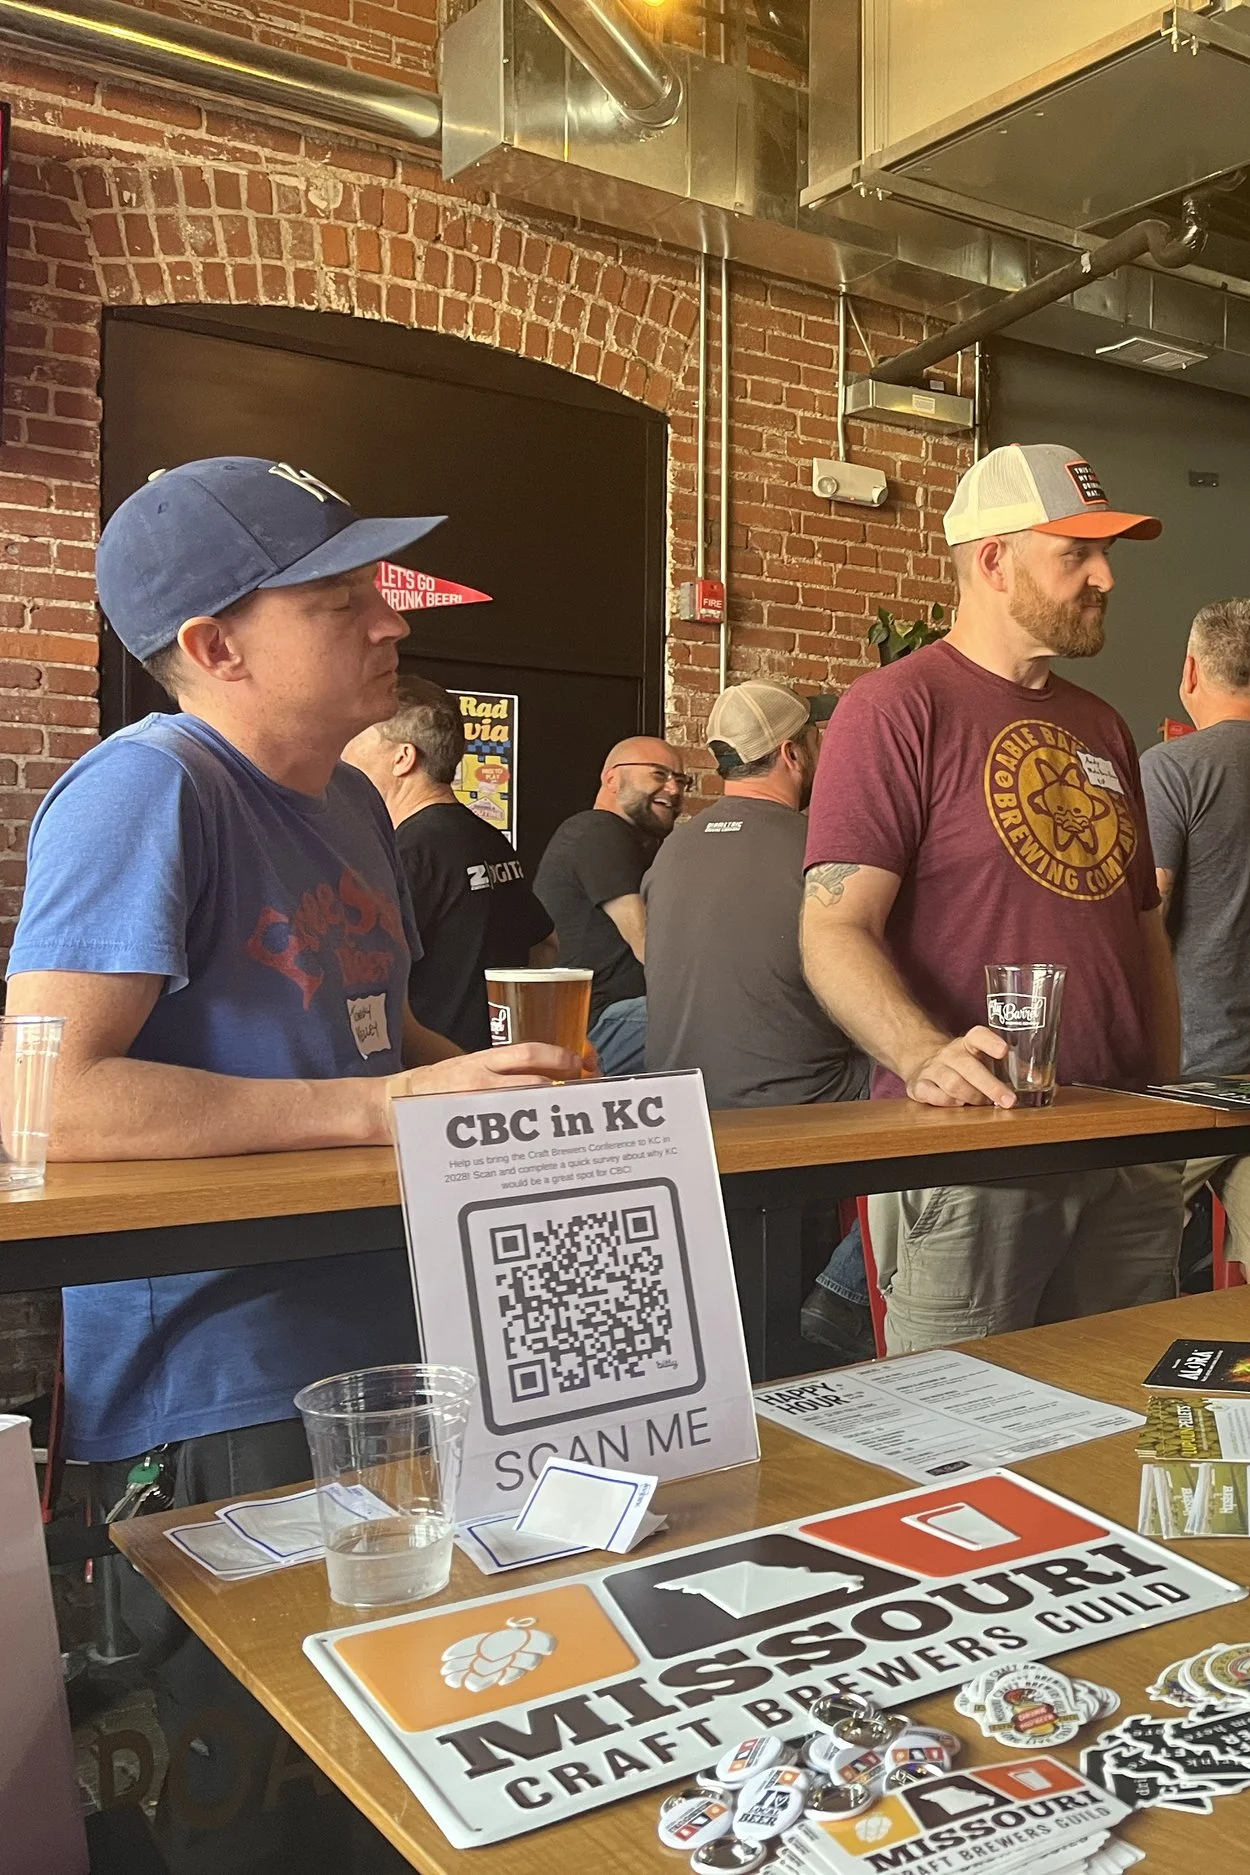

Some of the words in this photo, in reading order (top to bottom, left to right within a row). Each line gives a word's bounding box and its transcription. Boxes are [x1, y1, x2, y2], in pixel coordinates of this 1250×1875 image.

[381, 562, 415, 589] LET'S
[417, 574, 435, 592] GO
[381, 588, 423, 612] DRINK
[426, 592, 463, 607] BEER!
[703, 598, 723, 608] FIRE
[459, 695, 509, 719] Rad
[995, 726, 1039, 772] ABLE
[993, 793, 1079, 891] BREWING
[1003, 1000, 1044, 1021] Barrel
[446, 1108, 540, 1148] CBC
[551, 1104, 594, 1138] in
[602, 1096, 666, 1132] KC
[449, 1158, 471, 1169] Help
[473, 1157, 484, 1166] us
[486, 1152, 510, 1166] bring
[511, 1151, 526, 1161] the
[528, 1148, 550, 1160] Craft
[552, 1145, 588, 1157] Brewers
[589, 1140, 637, 1153] Conference
[638, 1138, 646, 1146] to
[648, 1137, 662, 1146] KC
[663, 1135, 671, 1144] in
[473, 1169, 497, 1180] Scan
[499, 1166, 516, 1176] and
[518, 1162, 558, 1175] complete
[568, 1157, 591, 1171] quick
[593, 1154, 620, 1167] survey
[622, 1151, 646, 1162] about
[647, 1149, 664, 1160] why
[665, 1146, 679, 1156] KC
[501, 1178, 528, 1189] would
[530, 1177, 542, 1187] be
[552, 1171, 574, 1185] great
[576, 1169, 595, 1182] spot
[596, 1167, 608, 1178] for
[756, 1381, 837, 1406] HAPPY
[778, 1392, 848, 1416] HOUR
[495, 1423, 628, 1491] SCAN
[645, 1406, 711, 1457] ME
[436, 1543, 1169, 1778] MISSOURI
[503, 1717, 723, 1811] CRAFT
[743, 1620, 1028, 1728] BREWERS
[1042, 1580, 1192, 1635] GUILD
[1184, 1724, 1223, 1742] here
[737, 1813, 780, 1828] BEER
[863, 1790, 1109, 1875] MISSOURI
[962, 1823, 1052, 1863] BREWERS
[1050, 1806, 1111, 1832] GUILD
